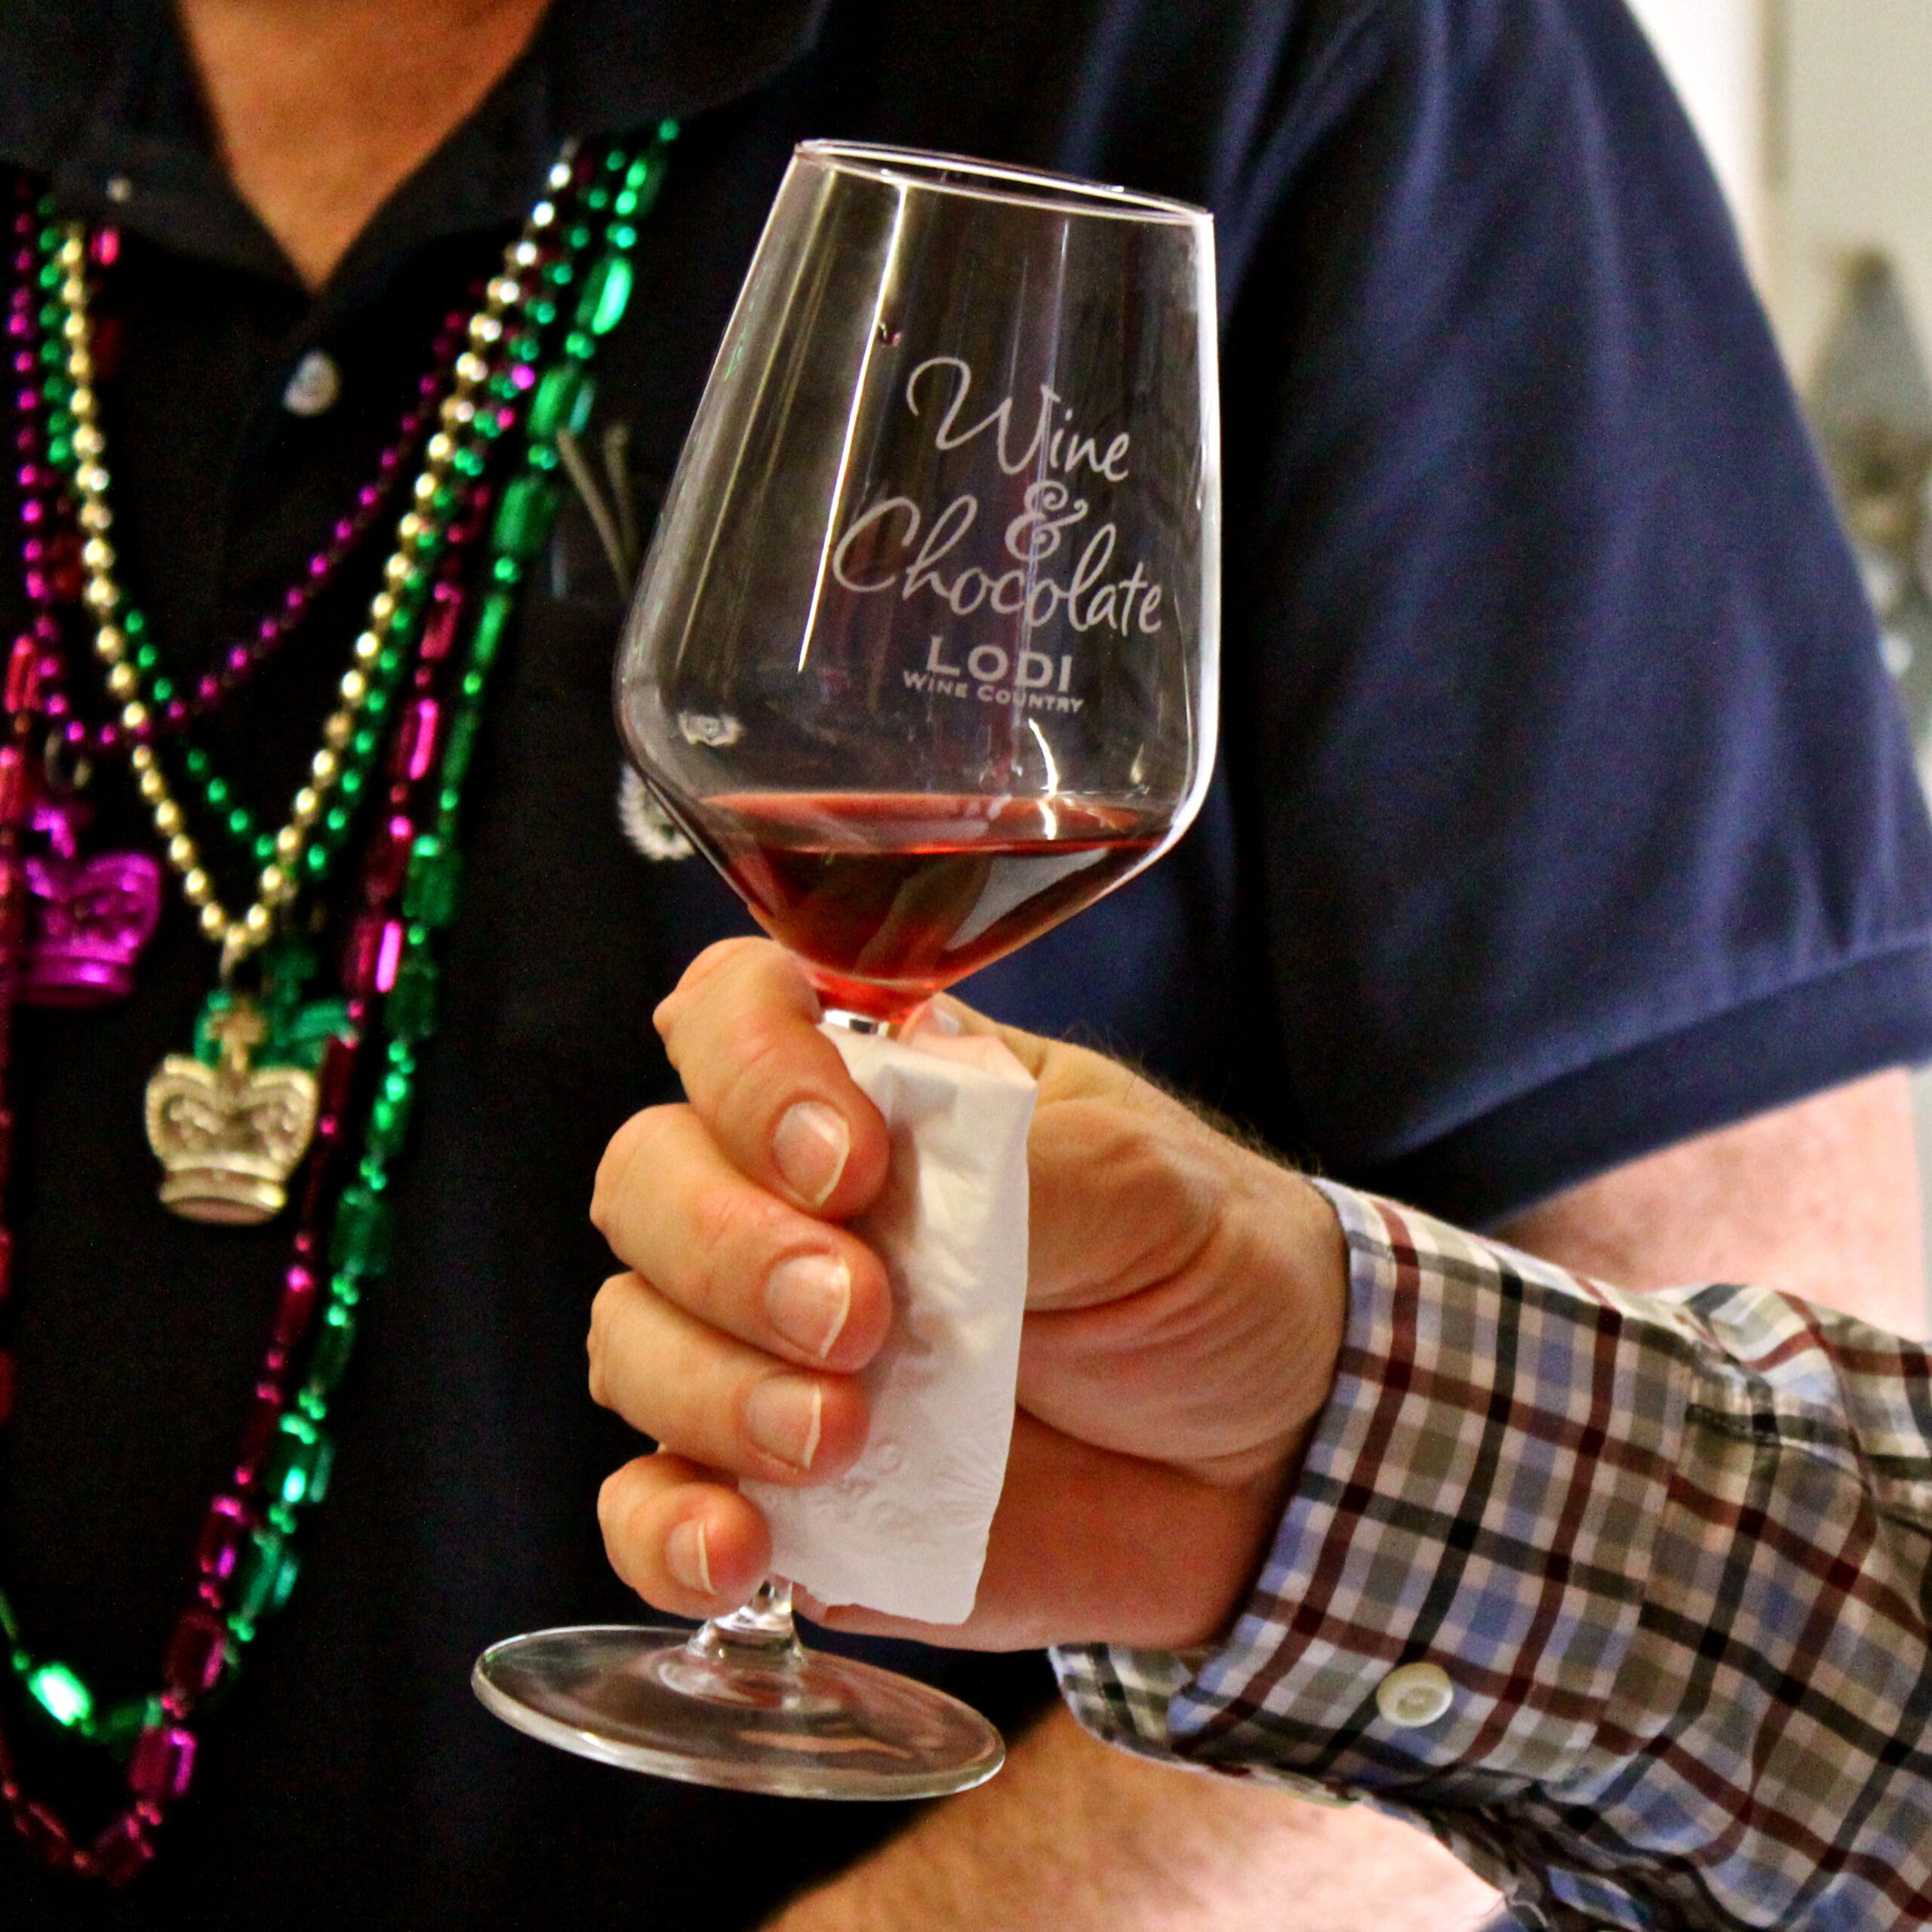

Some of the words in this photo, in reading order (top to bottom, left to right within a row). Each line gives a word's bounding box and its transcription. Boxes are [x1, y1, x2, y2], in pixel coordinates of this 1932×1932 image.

[906, 356, 1130, 481] Wine
[1004, 480, 1088, 561] &
[832, 494, 1161, 635] Chocolate
[904, 670, 968, 699] WINE
[977, 684, 1084, 714] COUNTRY
[927, 635, 1072, 693] LODI
